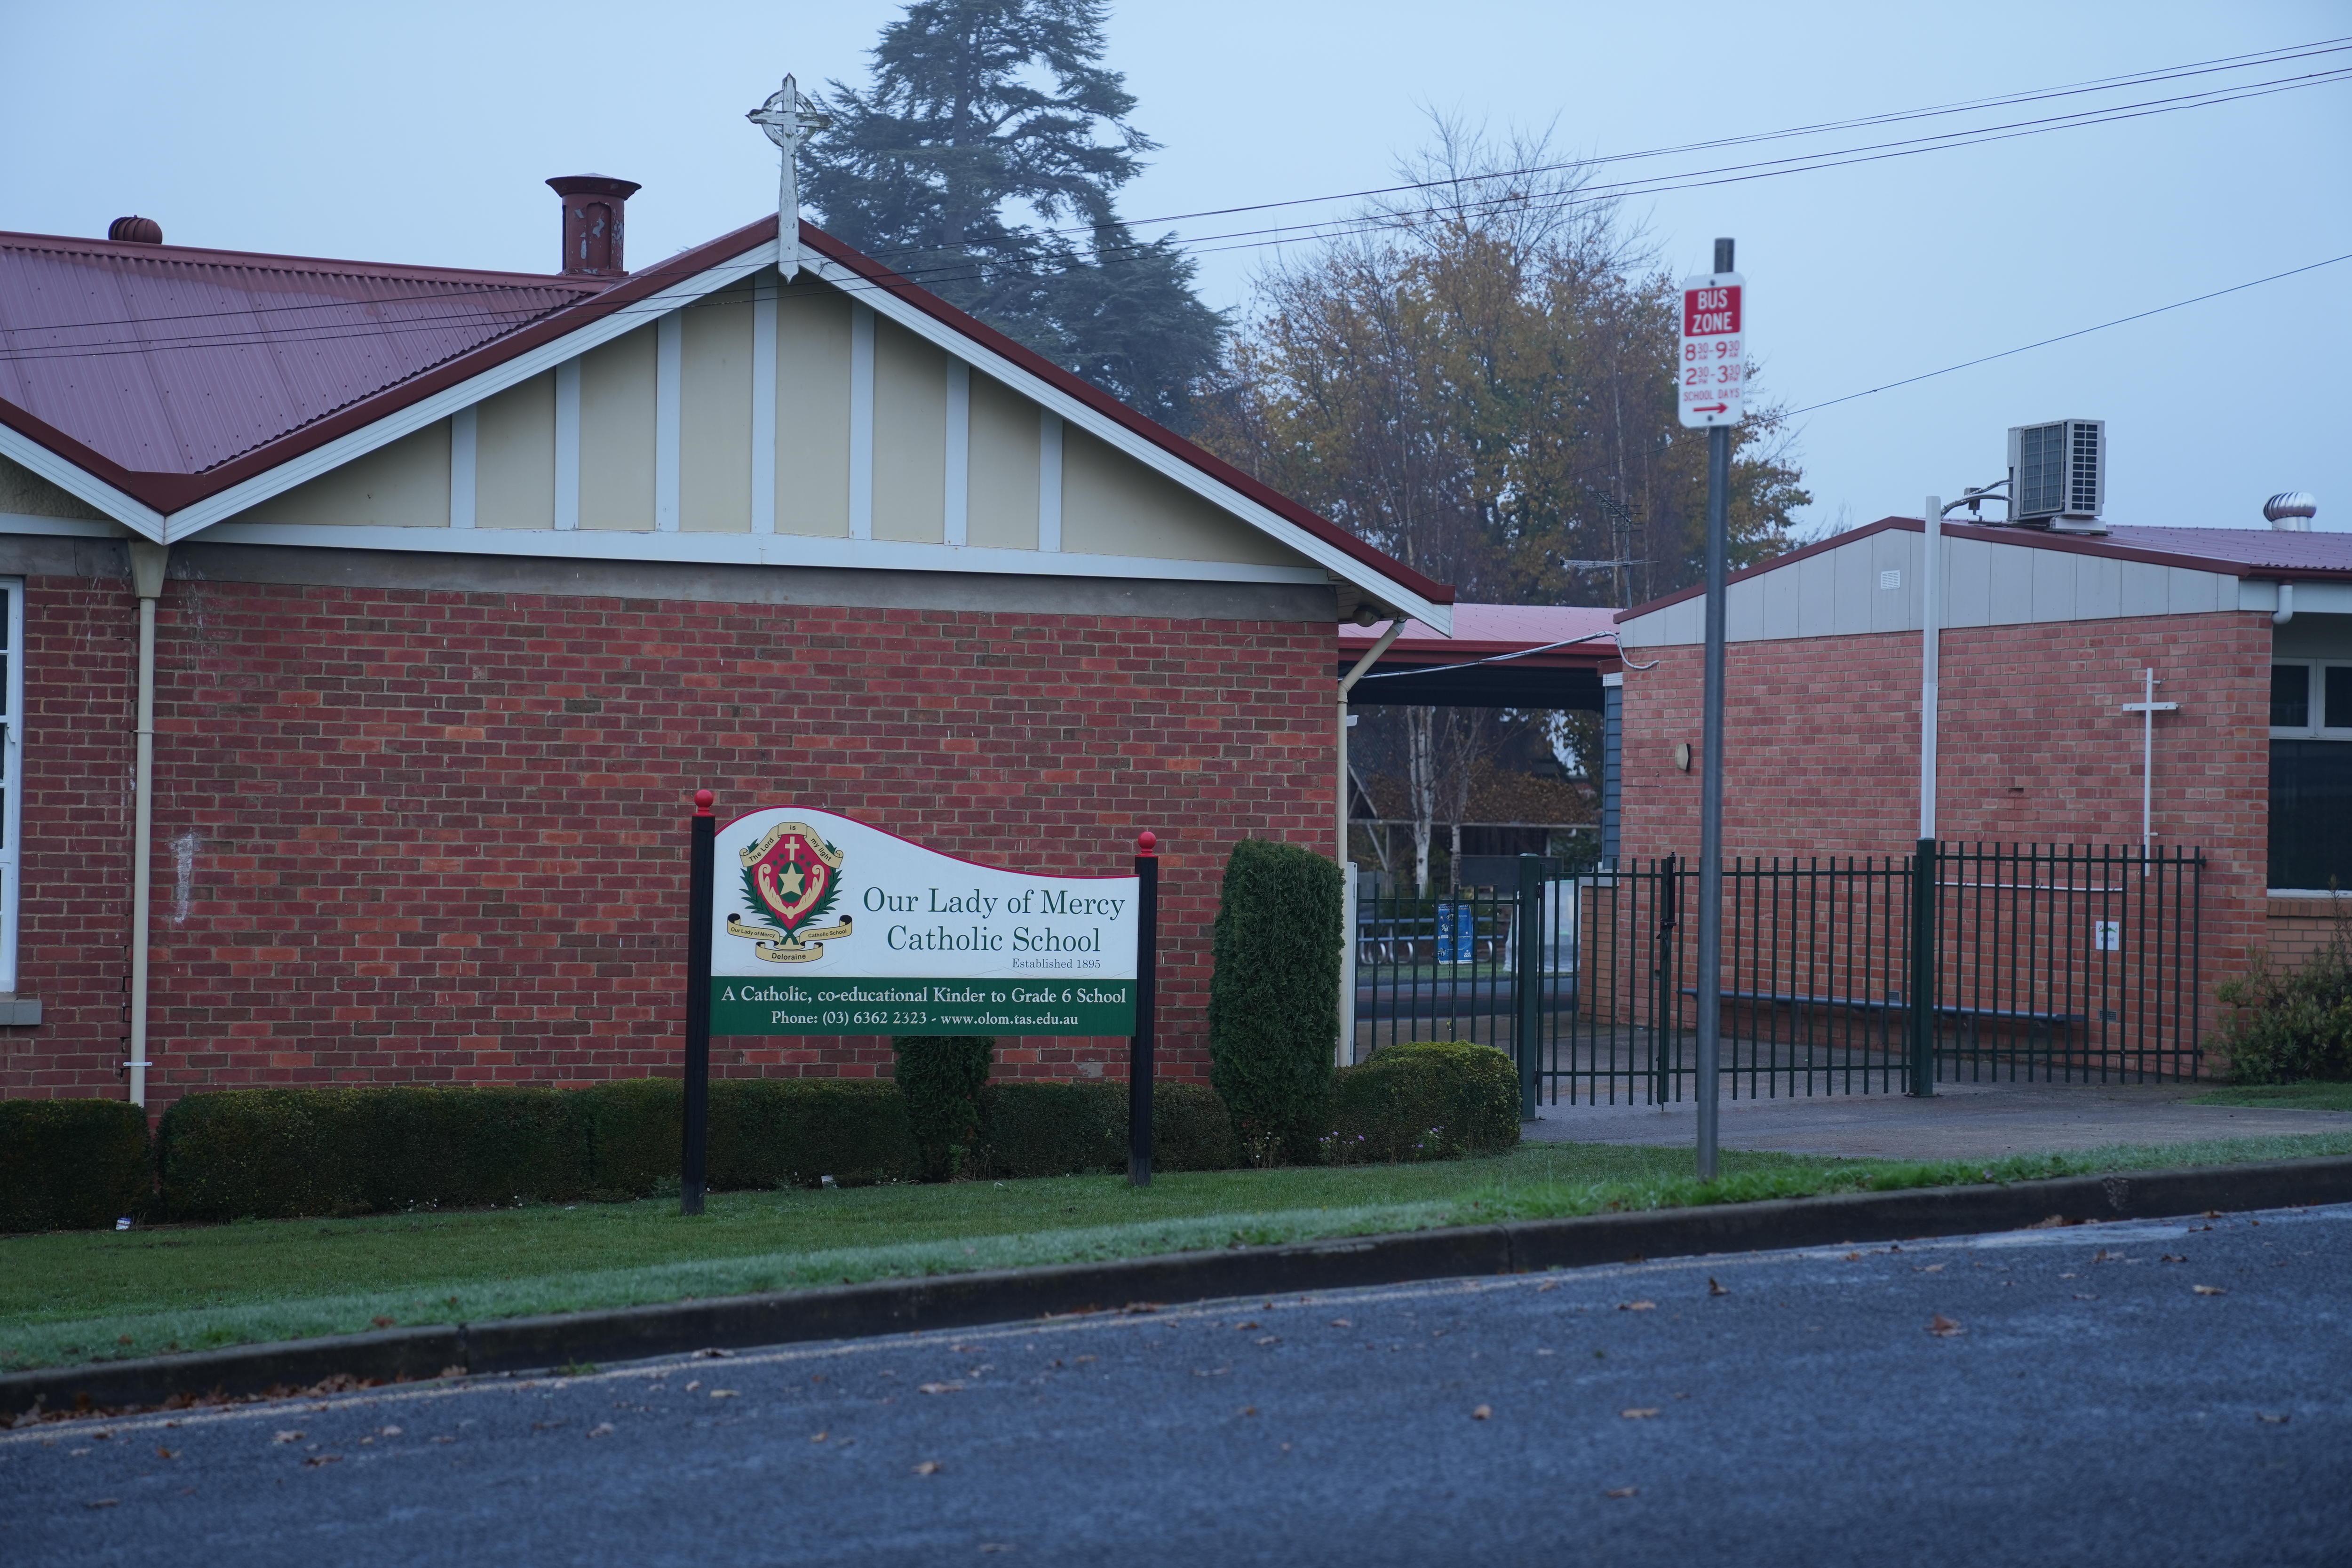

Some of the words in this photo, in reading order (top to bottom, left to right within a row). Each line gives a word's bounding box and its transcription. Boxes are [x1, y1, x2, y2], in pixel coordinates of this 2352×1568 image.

[1698, 289, 1728, 310] BUS
[1692, 311, 1733, 333] ZONE
[1684, 390, 1714, 401] SCHOOL
[1718, 388, 1740, 399] DAYS
[748, 852, 762, 862] The
[760, 837, 774, 852] Lord
[810, 838, 819, 848] my
[818, 847, 831, 861] light
[864, 886, 919, 912] Our
[928, 887, 998, 920] Lady
[1008, 889, 1035, 914] of
[1040, 889, 1126, 921] Mercy
[887, 924, 1002, 952] Catholic
[1013, 926, 1101, 953] School
[771, 952, 806, 961] Deloraine
[1012, 958, 1073, 969] Established
[1077, 959, 1101, 969] 1895
[721, 986, 736, 1001] A
[741, 985, 812, 1004] Catholic,
[817, 985, 928, 1003] co-educational
[933, 986, 986, 1003] Kinder
[991, 990, 1006, 1003] to
[1011, 987, 1057, 1003] Grade
[1062, 987, 1072, 1003] 6
[1077, 987, 1127, 1003] School
[771, 1010, 818, 1024] Phone:
[822, 1011, 850, 1026] (03)
[853, 1011, 888, 1024] 6362
[893, 1011, 927, 1024] 2323
[940, 1011, 1078, 1025] www.olom.tas.edu.au
